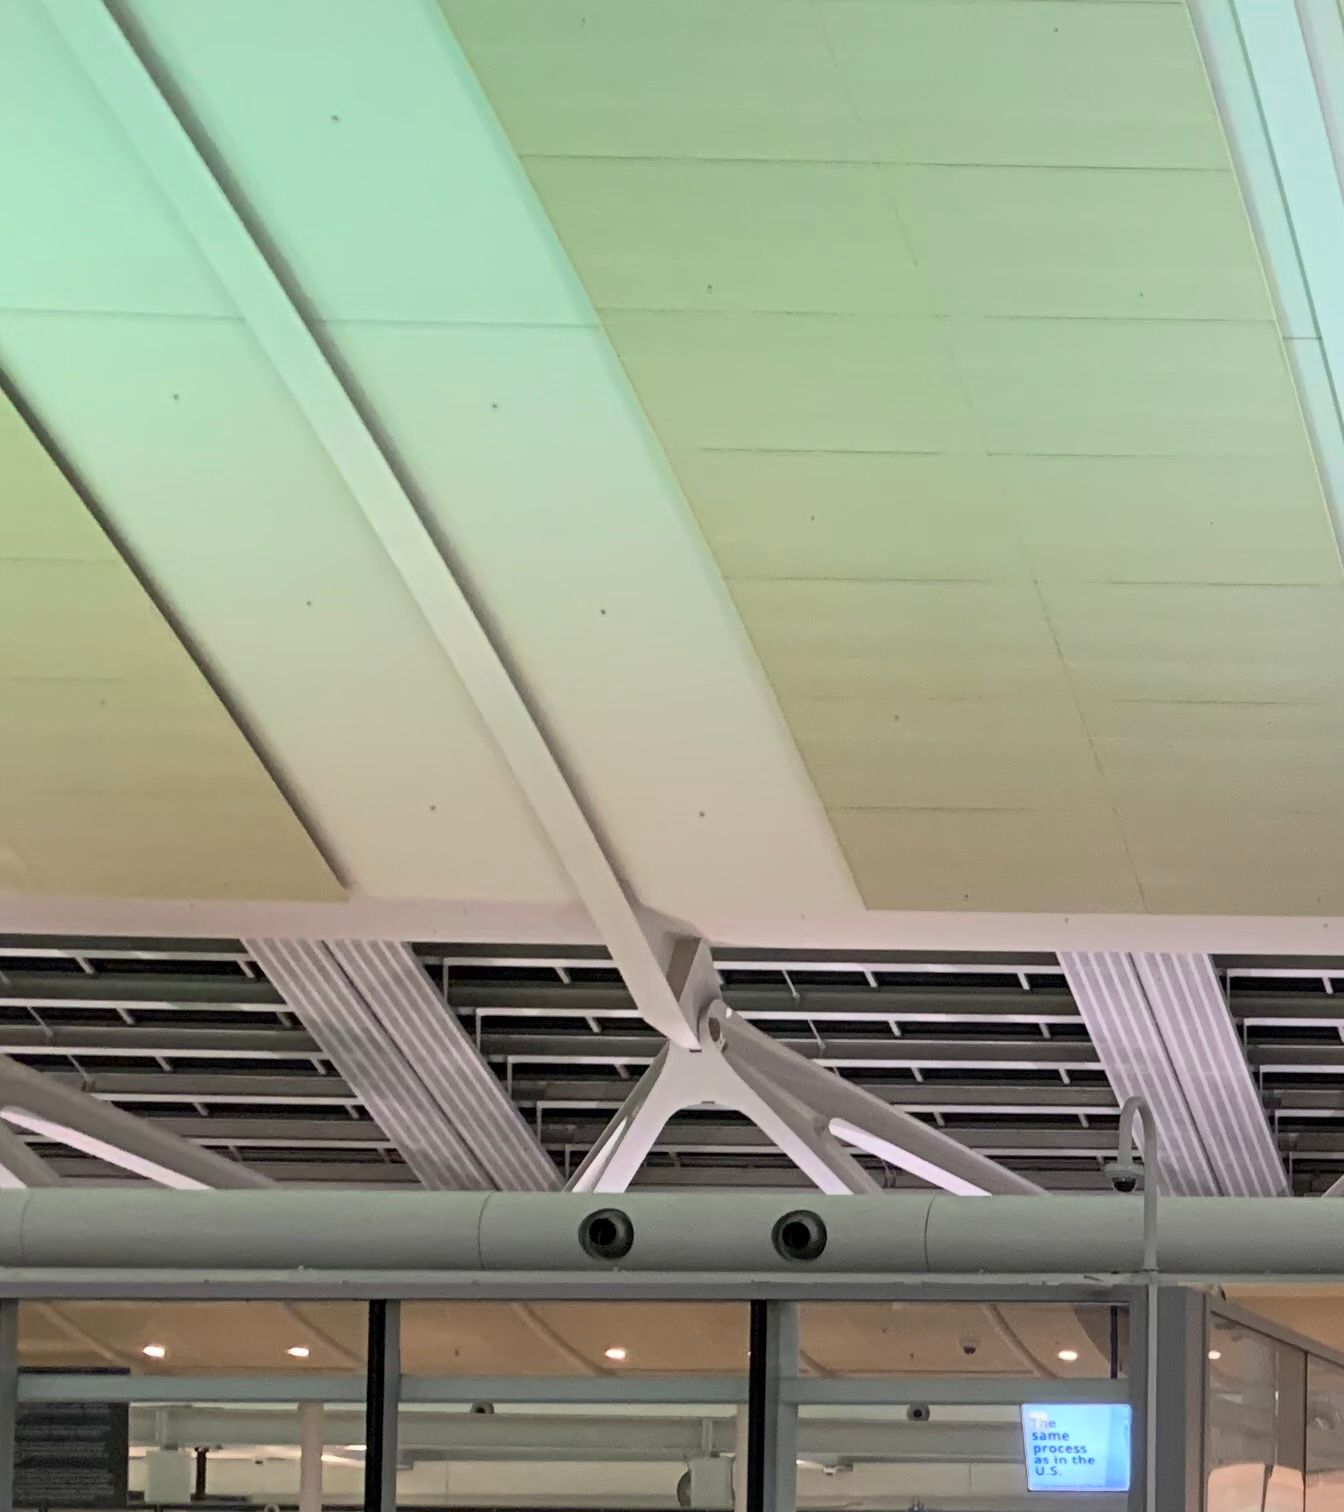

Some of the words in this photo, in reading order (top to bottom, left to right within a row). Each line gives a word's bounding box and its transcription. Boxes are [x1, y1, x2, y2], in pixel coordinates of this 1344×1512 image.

[1032, 1432, 1070, 1441] same
[1033, 1444, 1087, 1456] process
[1034, 1456, 1049, 1465] as
[1055, 1456, 1067, 1465] in
[1072, 1456, 1095, 1465] the
